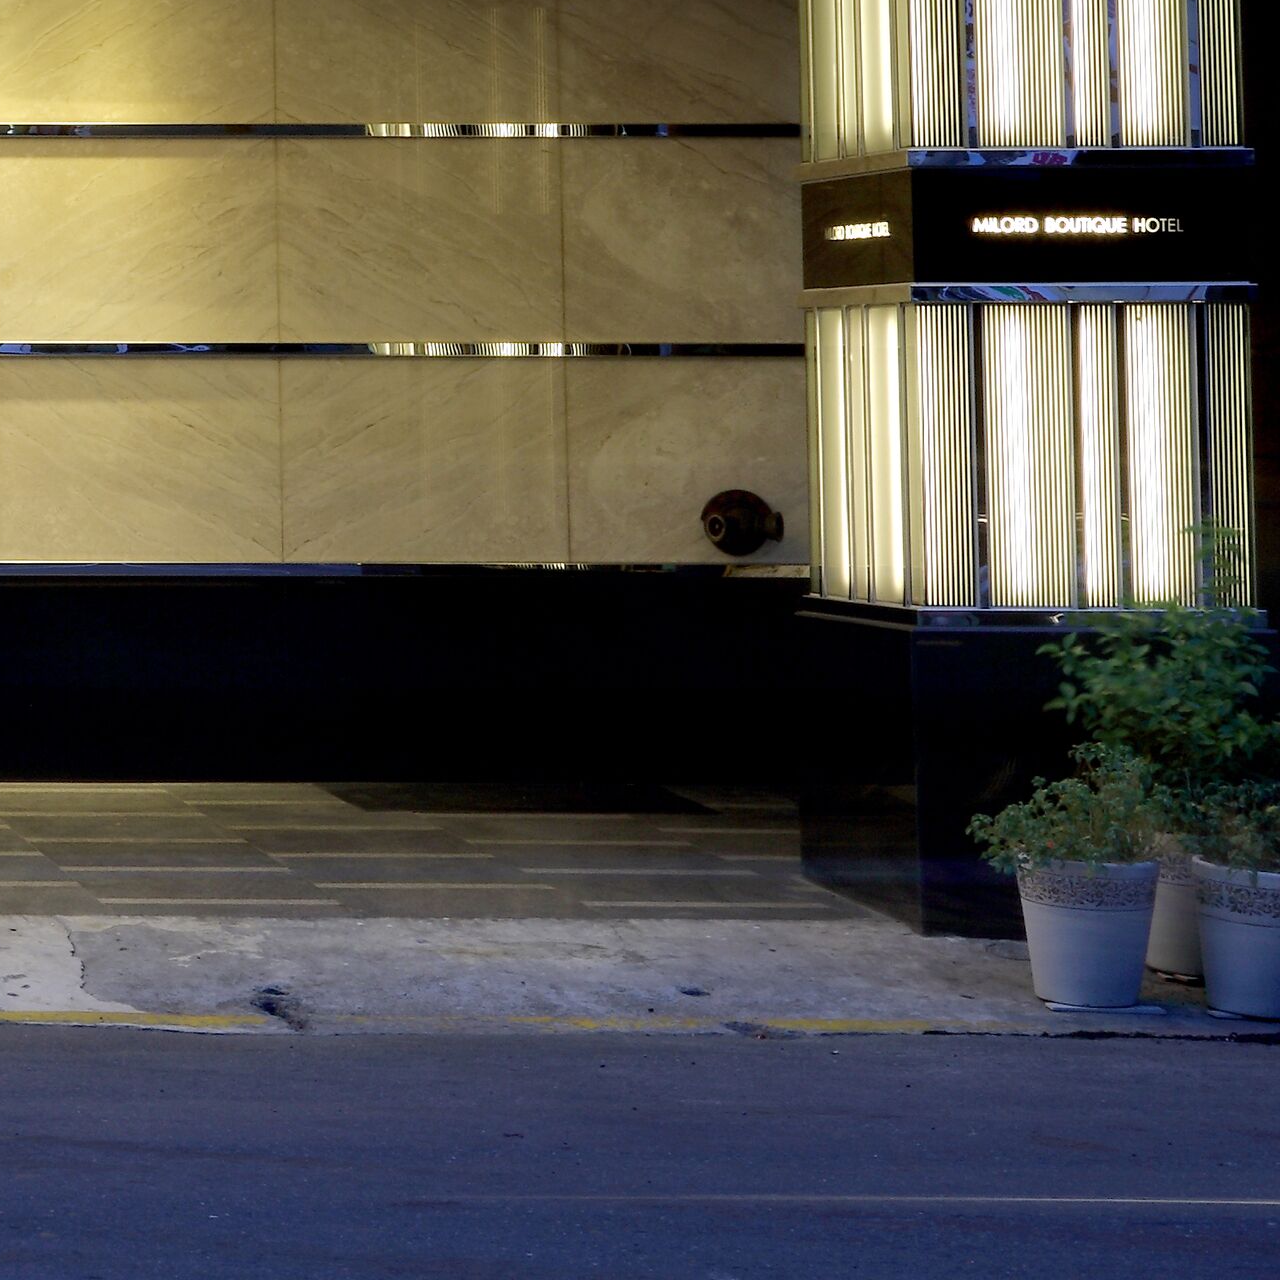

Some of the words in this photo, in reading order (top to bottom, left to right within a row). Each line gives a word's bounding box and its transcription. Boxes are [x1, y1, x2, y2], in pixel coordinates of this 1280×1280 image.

[972, 217, 1040, 234] MILORD
[1043, 217, 1128, 235] BOUTIQUE
[1133, 218, 1184, 233] HOTEL
